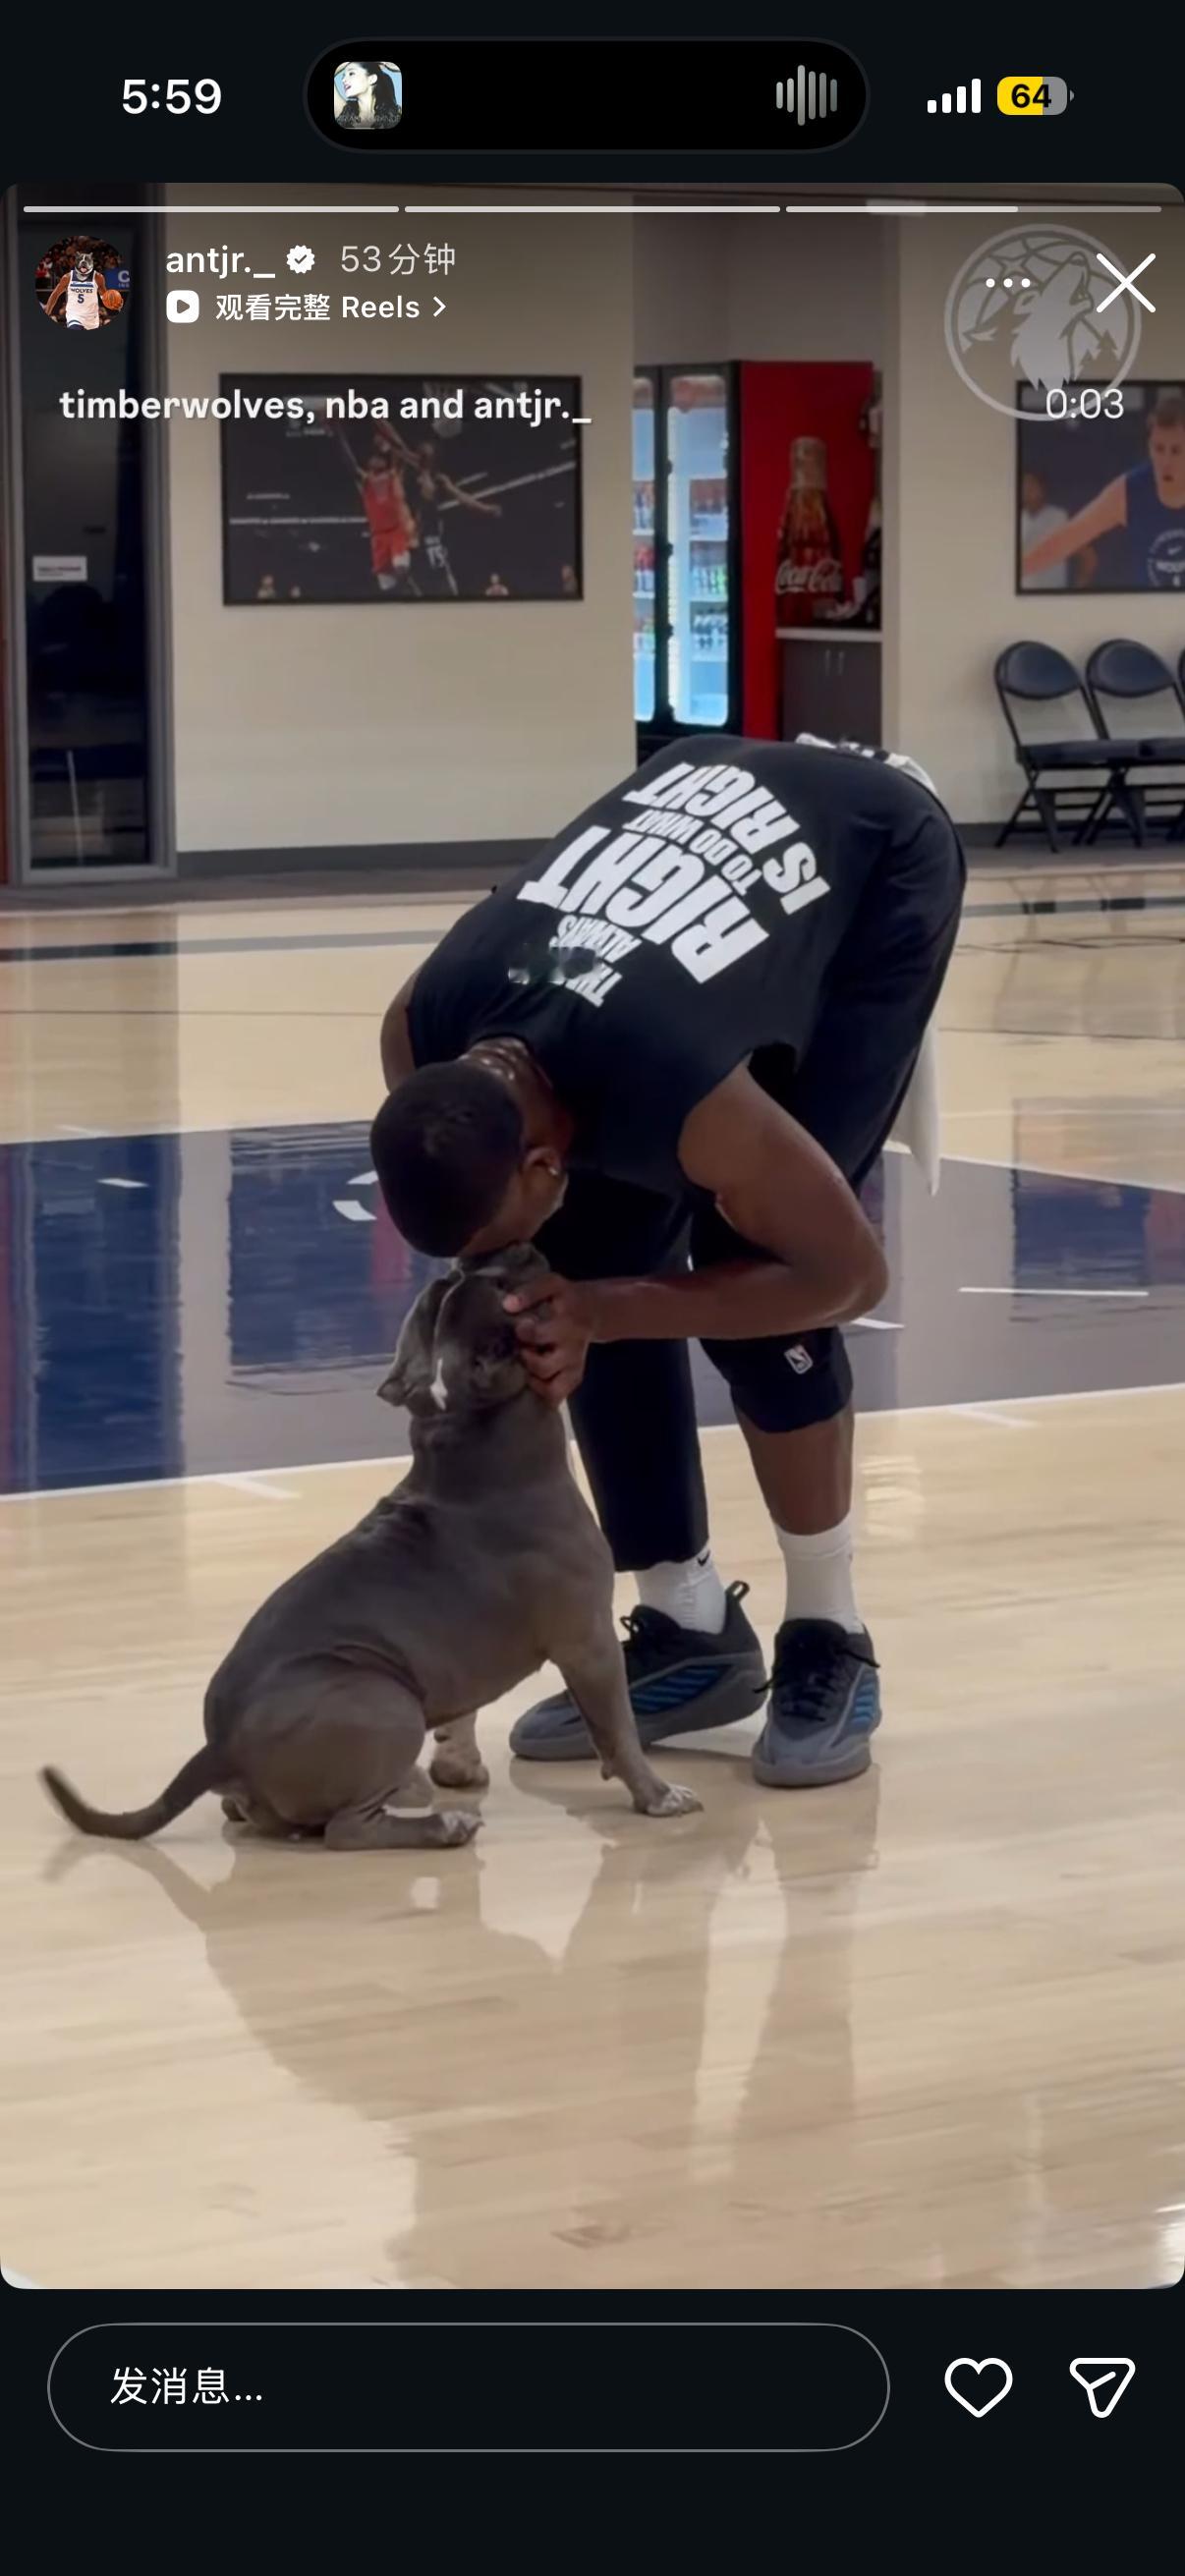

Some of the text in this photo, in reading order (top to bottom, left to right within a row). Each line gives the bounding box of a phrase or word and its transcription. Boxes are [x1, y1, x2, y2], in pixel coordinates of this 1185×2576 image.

[516, 824, 770, 984] RIGHT
[622, 761, 831, 915] IS RIGHT
[622, 809, 762, 896] TO DO WHAT
